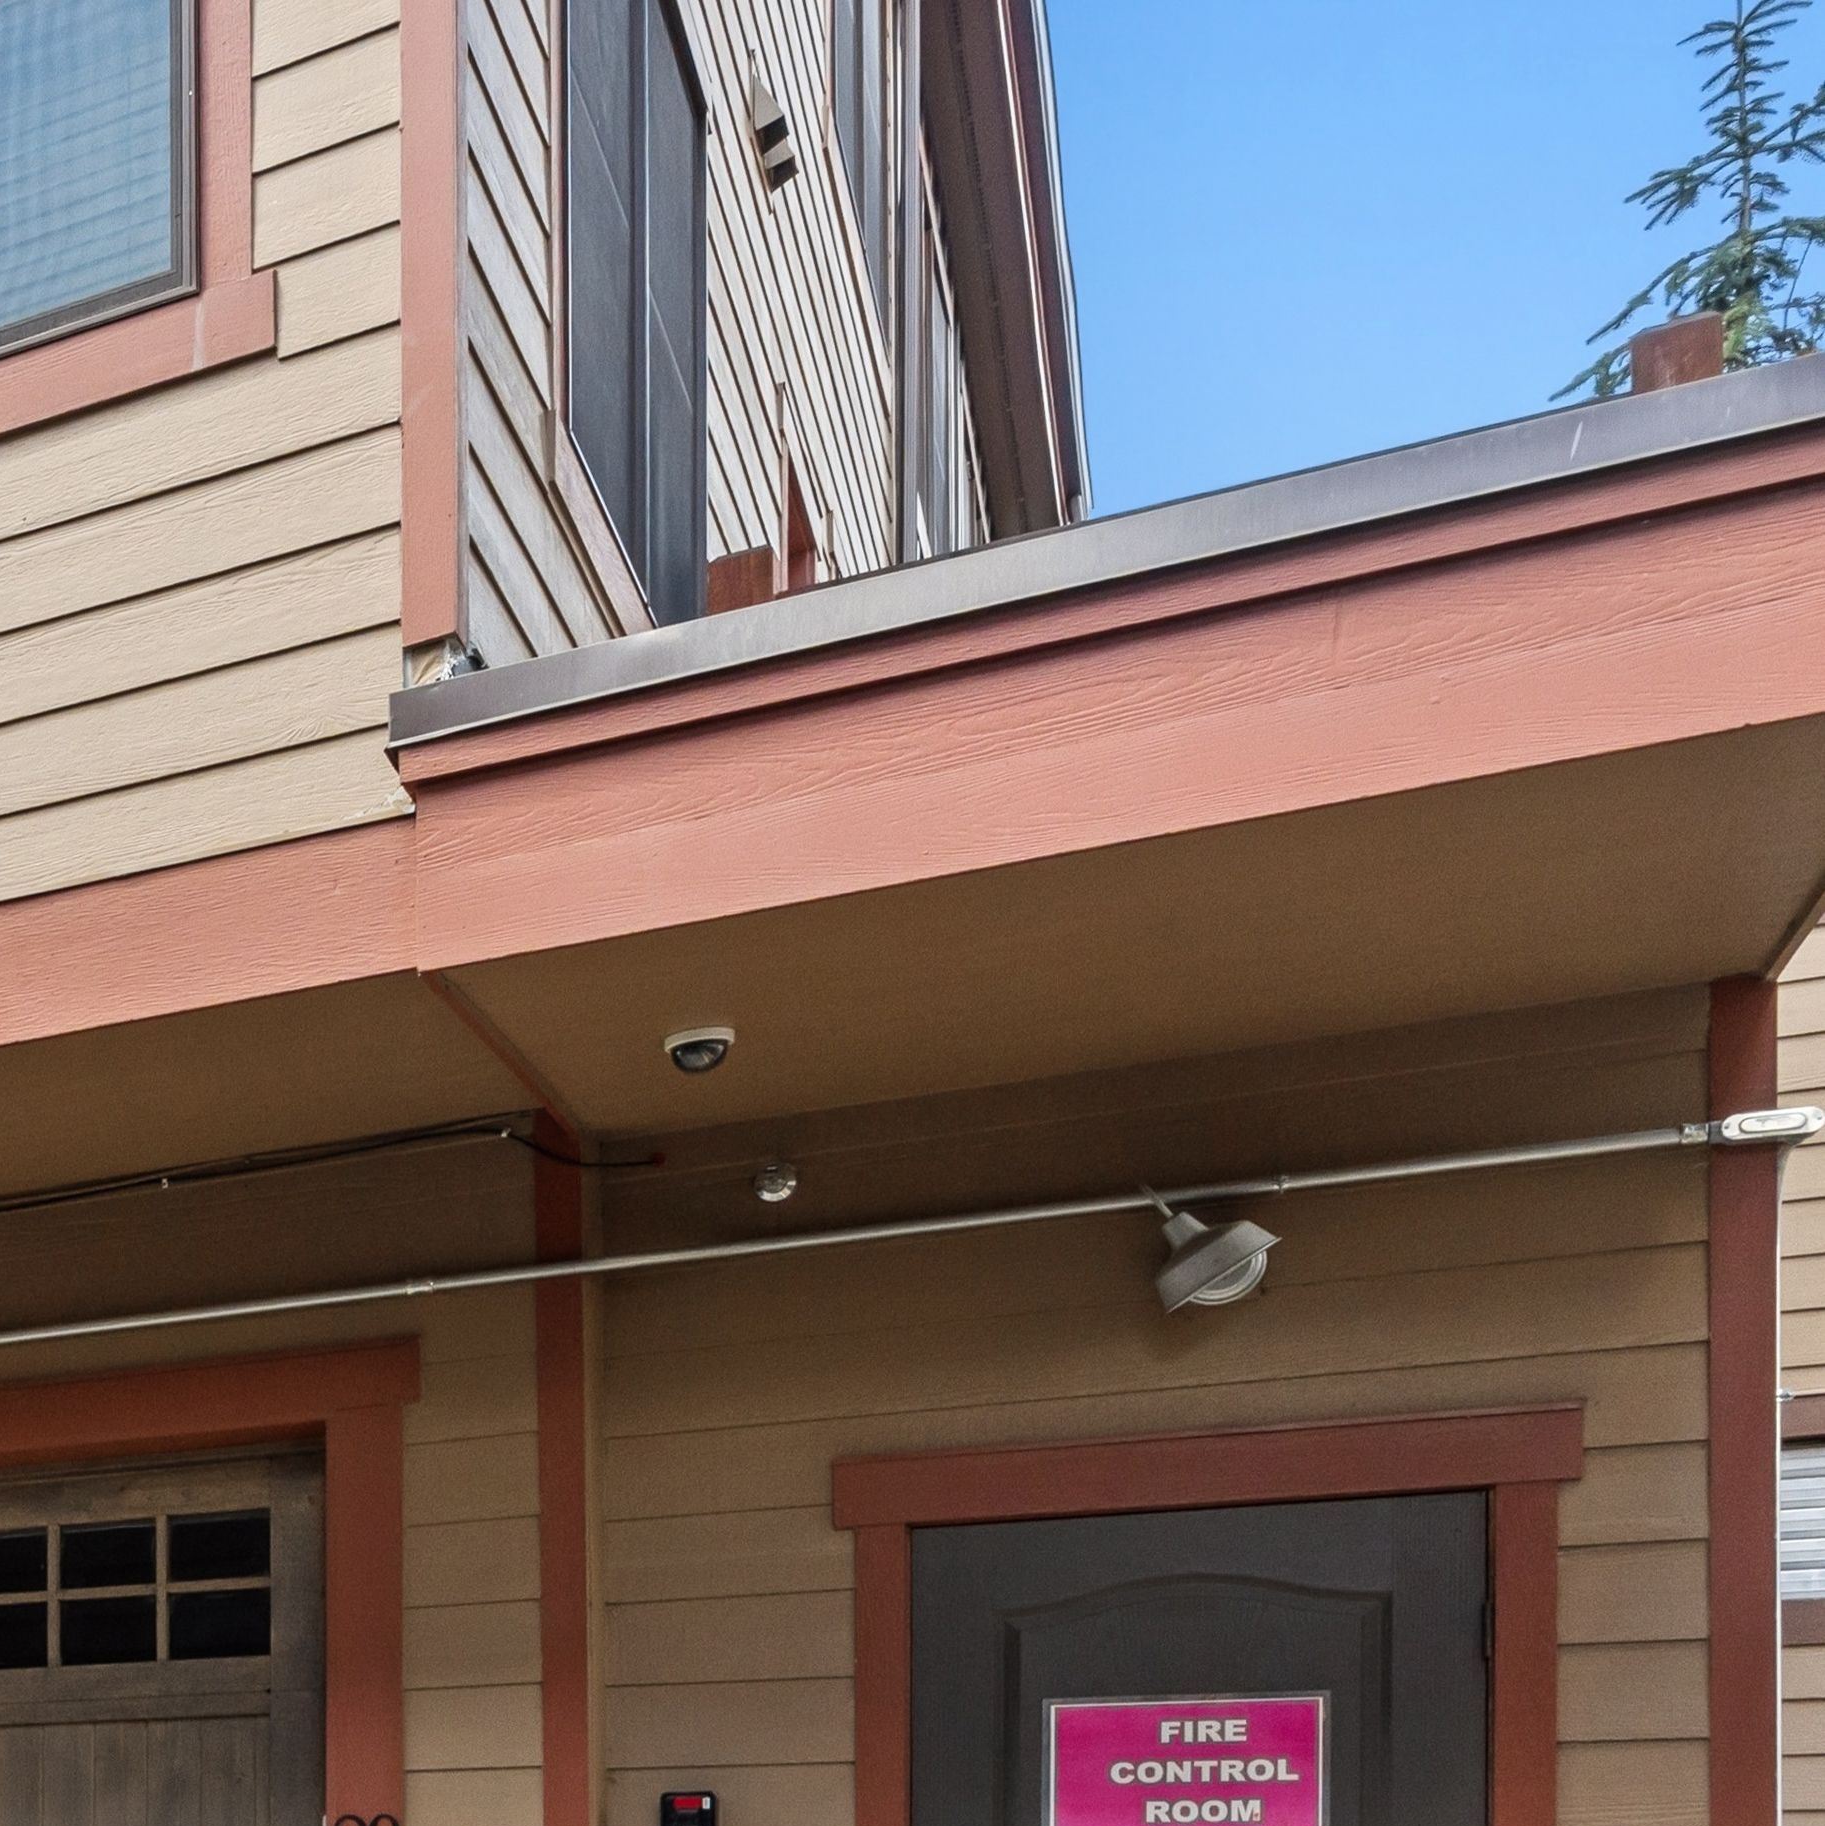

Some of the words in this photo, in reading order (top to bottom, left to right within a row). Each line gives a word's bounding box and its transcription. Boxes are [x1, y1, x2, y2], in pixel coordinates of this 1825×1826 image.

[1159, 1719, 1247, 1744] FIRE
[1109, 1758, 1299, 1785] CONTROL
[1145, 1800, 1261, 1823] ROOM
